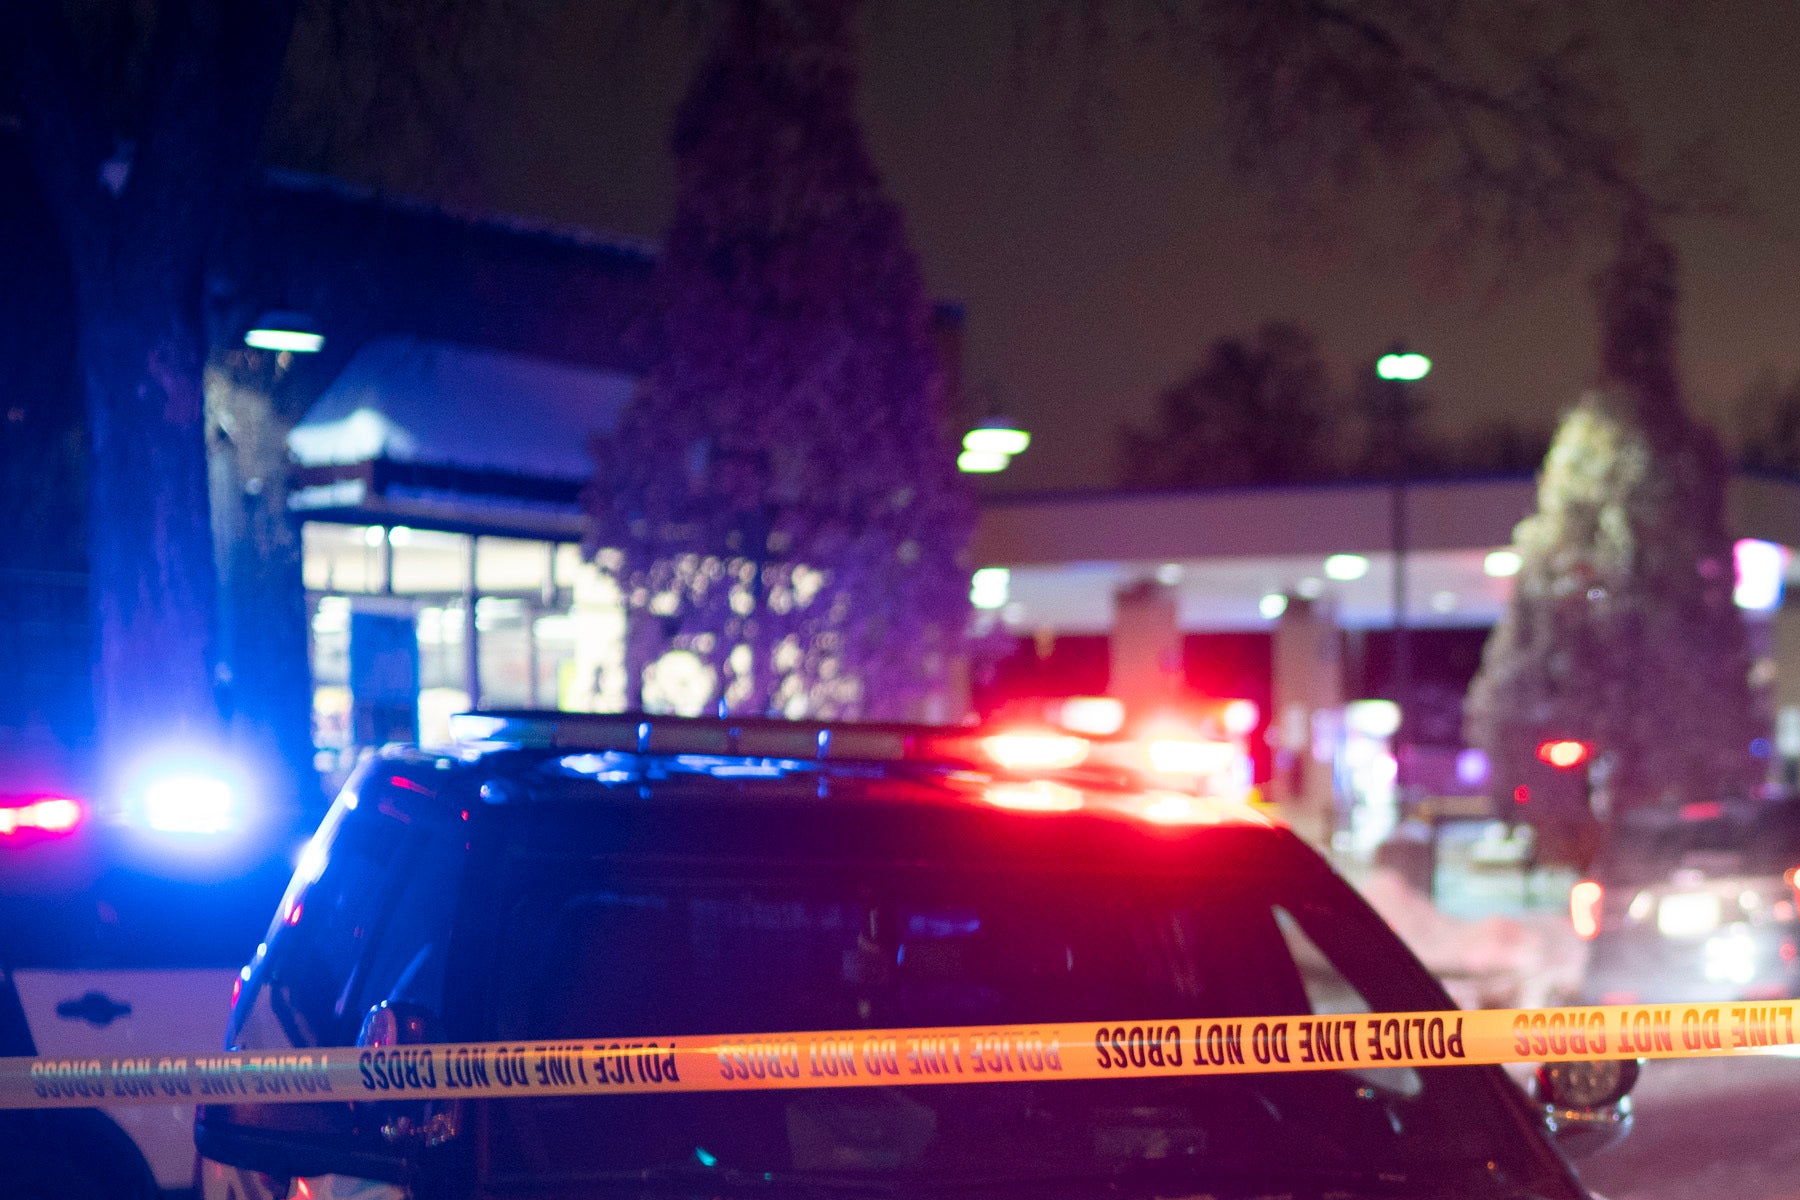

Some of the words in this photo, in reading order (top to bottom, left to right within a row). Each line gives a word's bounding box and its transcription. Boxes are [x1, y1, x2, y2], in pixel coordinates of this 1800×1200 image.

[1095, 1026, 1183, 1069] CROSS
[1194, 1024, 1244, 1066] NOT
[1252, 1022, 1290, 1063] DO
[1299, 1020, 1359, 1062] LINE
[1367, 1017, 1466, 1060] POLICE
[1512, 1012, 1606, 1056] CROSS
[1617, 1009, 1672, 1053] NOT
[1682, 1008, 1721, 1051] DO
[1730, 1006, 1793, 1048] LINE
[359, 1048, 437, 1090] CROSS
[444, 1047, 490, 1088] NOT
[495, 1046, 529, 1088] DO
[534, 1044, 587, 1086] LINE
[595, 1042, 680, 1083] POLICE
[718, 1037, 799, 1081] CROSS
[809, 1036, 857, 1078] NOT
[862, 1035, 899, 1076] DO
[906, 1033, 963, 1074] LINE
[970, 1030, 1063, 1073] POLICE
